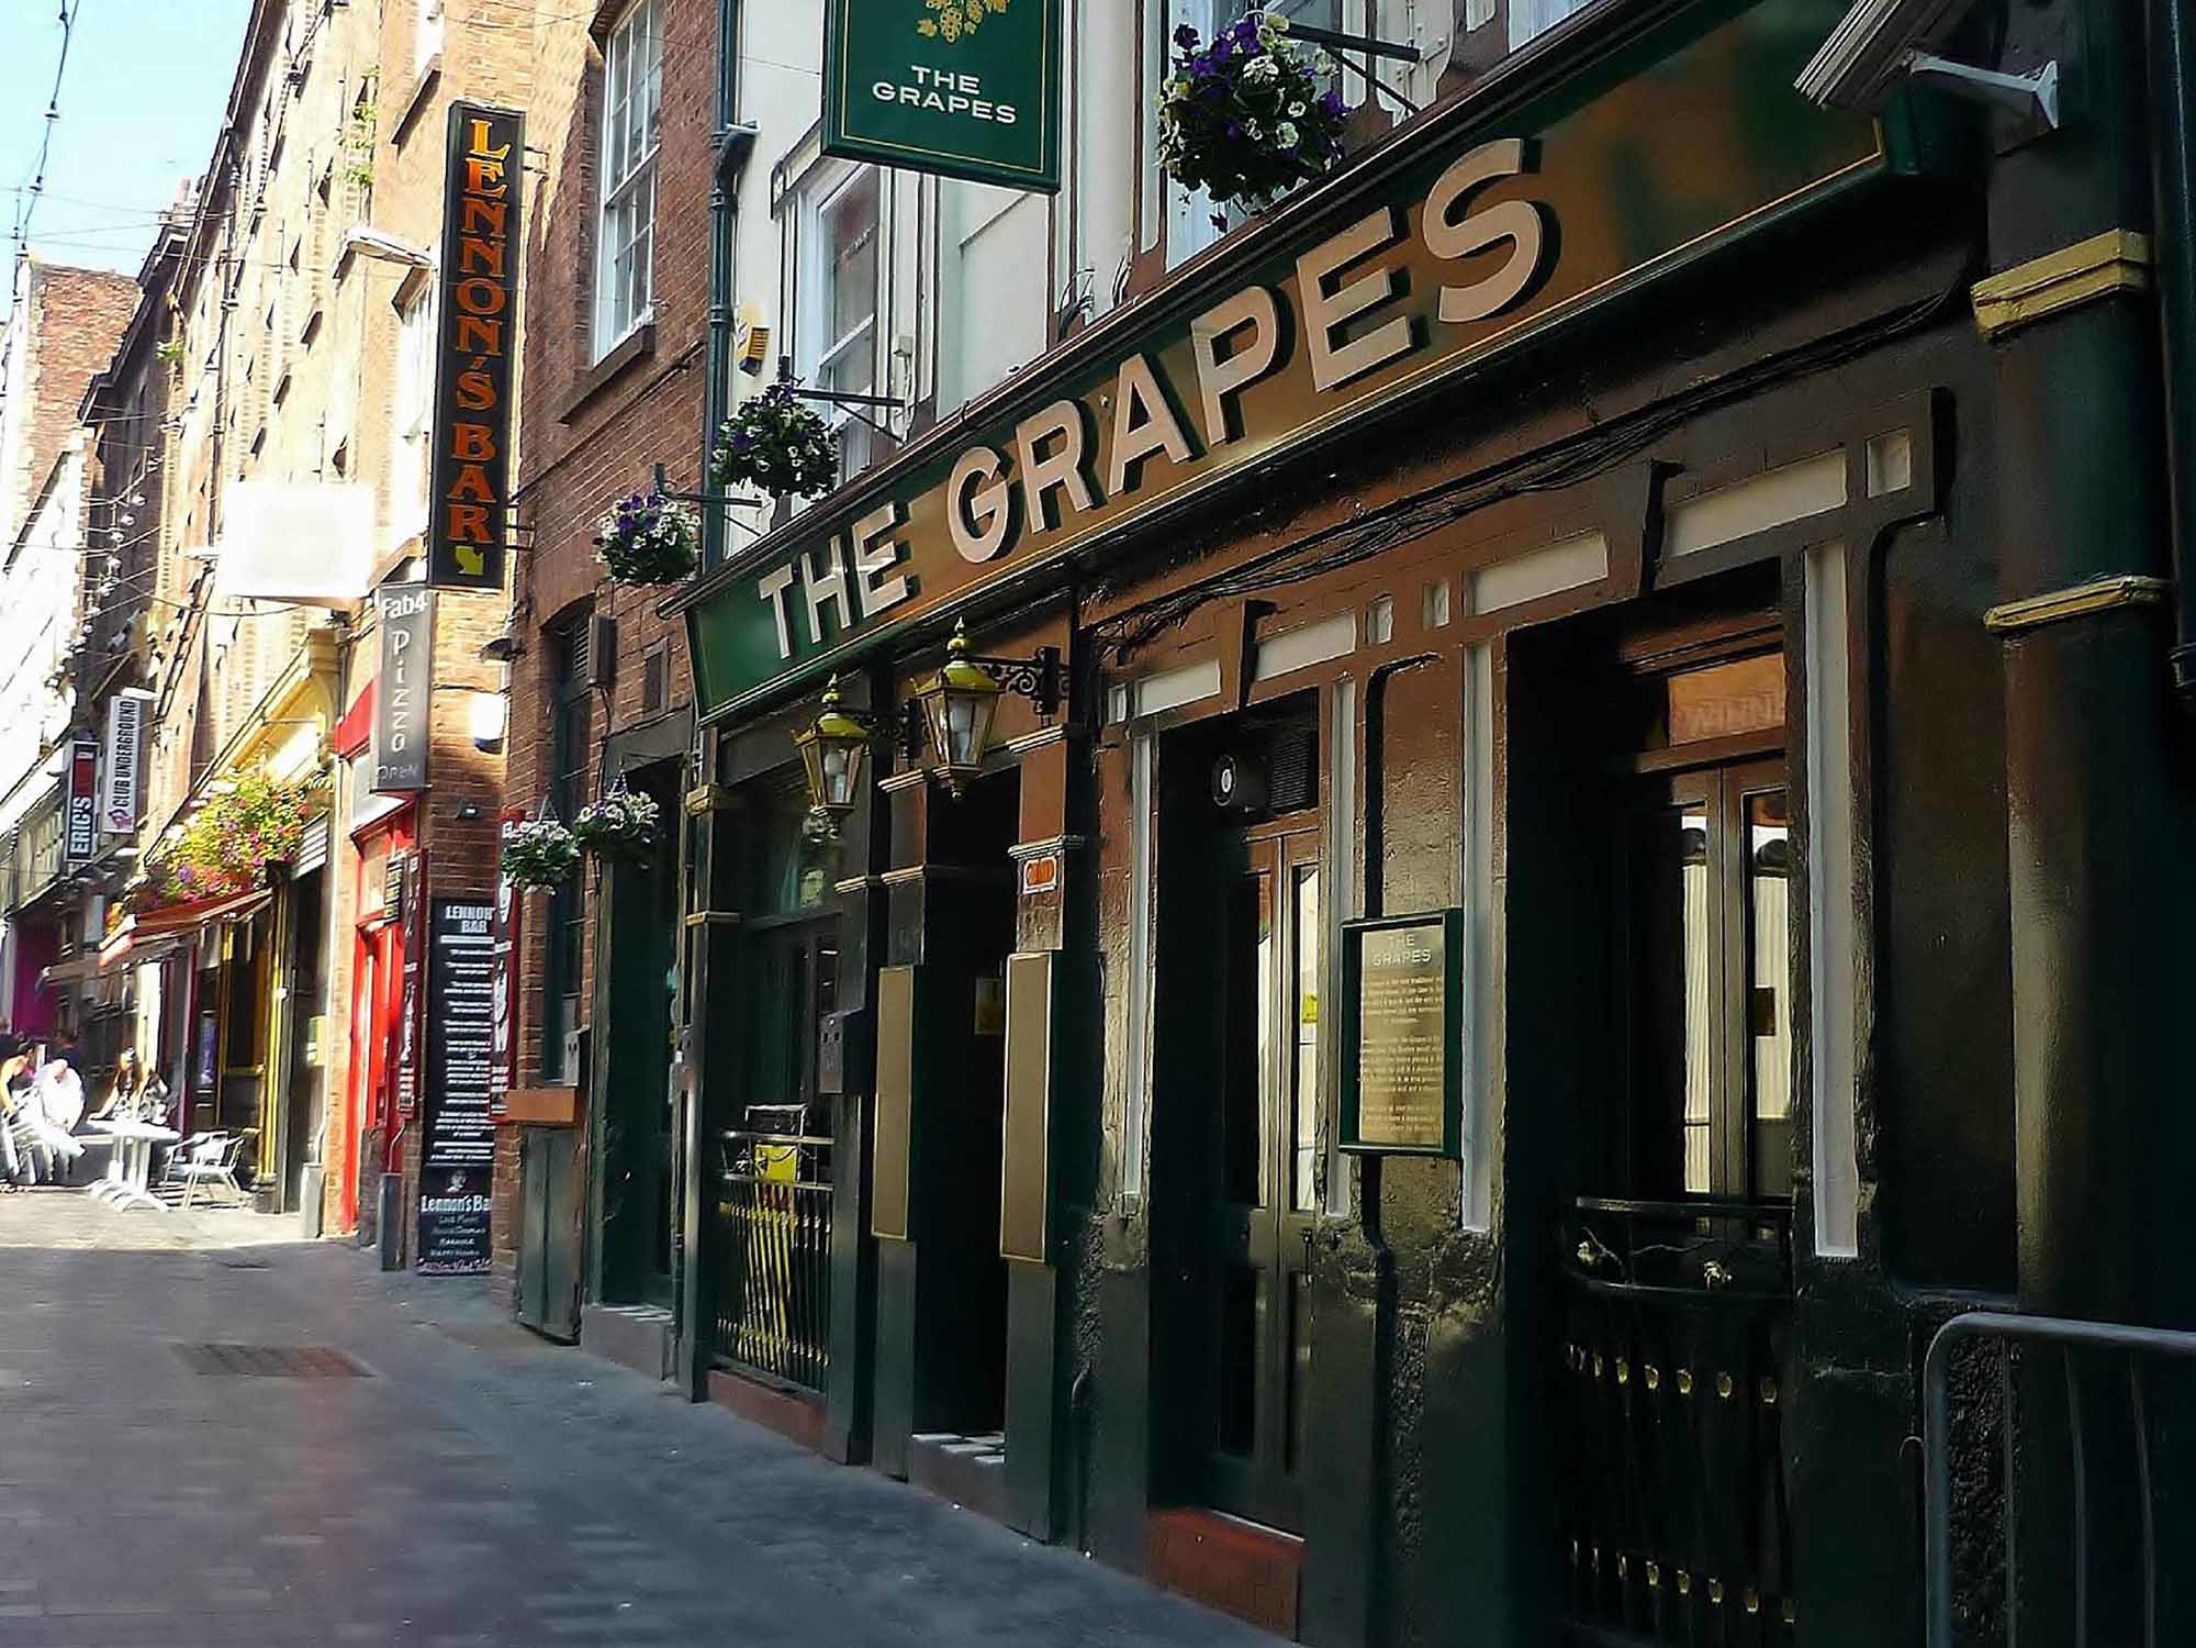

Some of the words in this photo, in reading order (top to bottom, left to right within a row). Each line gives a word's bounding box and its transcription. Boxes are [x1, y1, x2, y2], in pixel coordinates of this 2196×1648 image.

[872, 81, 1017, 124] GRAPES
[911, 64, 981, 95] THE
[455, 118, 512, 411] LENNON'S
[758, 501, 911, 661] THE
[947, 138, 1545, 565] GRAPES
[447, 422, 498, 545] BAR
[115, 700, 137, 778] UNDERGROUND
[112, 779, 131, 807] CLUB
[70, 796, 93, 854] ERIC'S
[1372, 948, 1432, 967] GRAPES
[1388, 933, 1416, 948] THE
